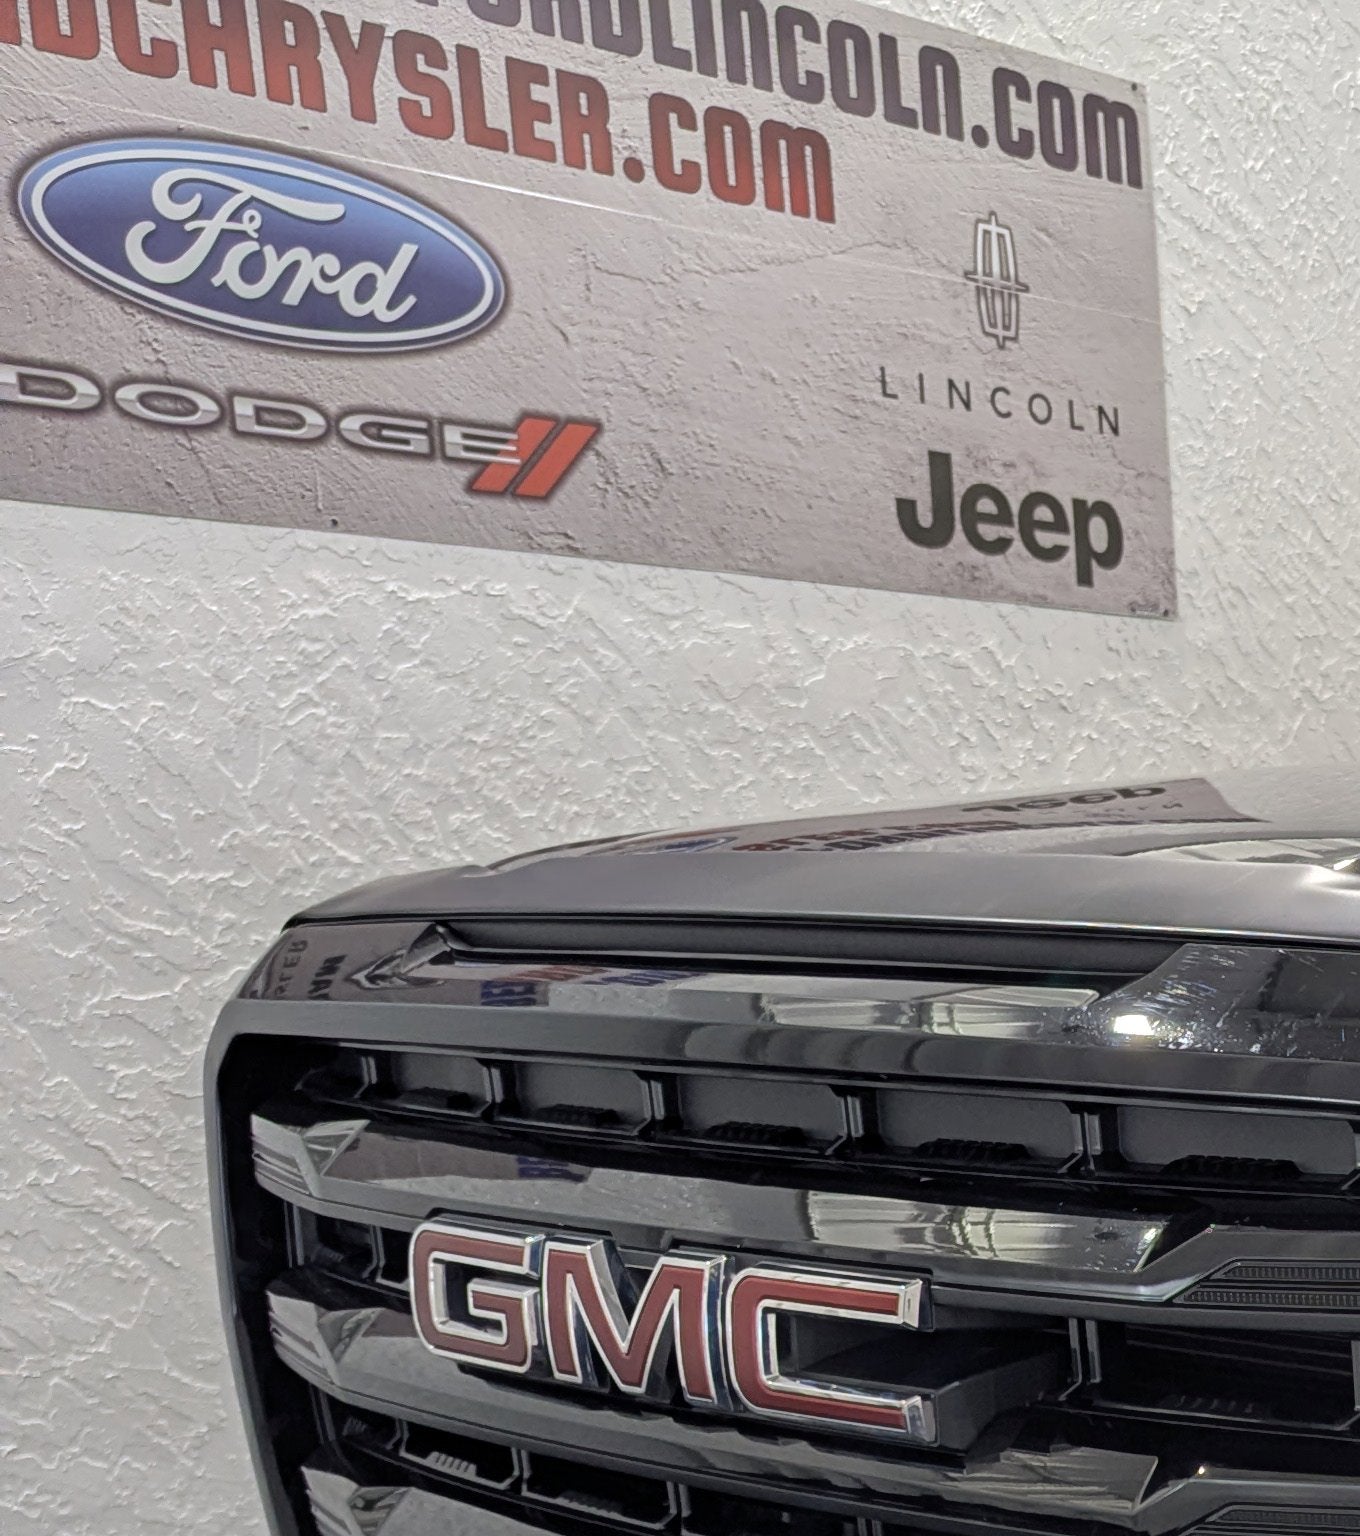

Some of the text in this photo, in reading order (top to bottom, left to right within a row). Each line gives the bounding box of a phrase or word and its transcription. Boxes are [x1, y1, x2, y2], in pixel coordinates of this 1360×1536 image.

[0, 0, 836, 224] DCHRYSLER.COM
[125, 168, 419, 323] Ford
[0, 361, 522, 465] DODGE
[879, 365, 1120, 437] LINCOLN
[895, 449, 1123, 588] Jeep
[409, 1209, 938, 1446] GMC
